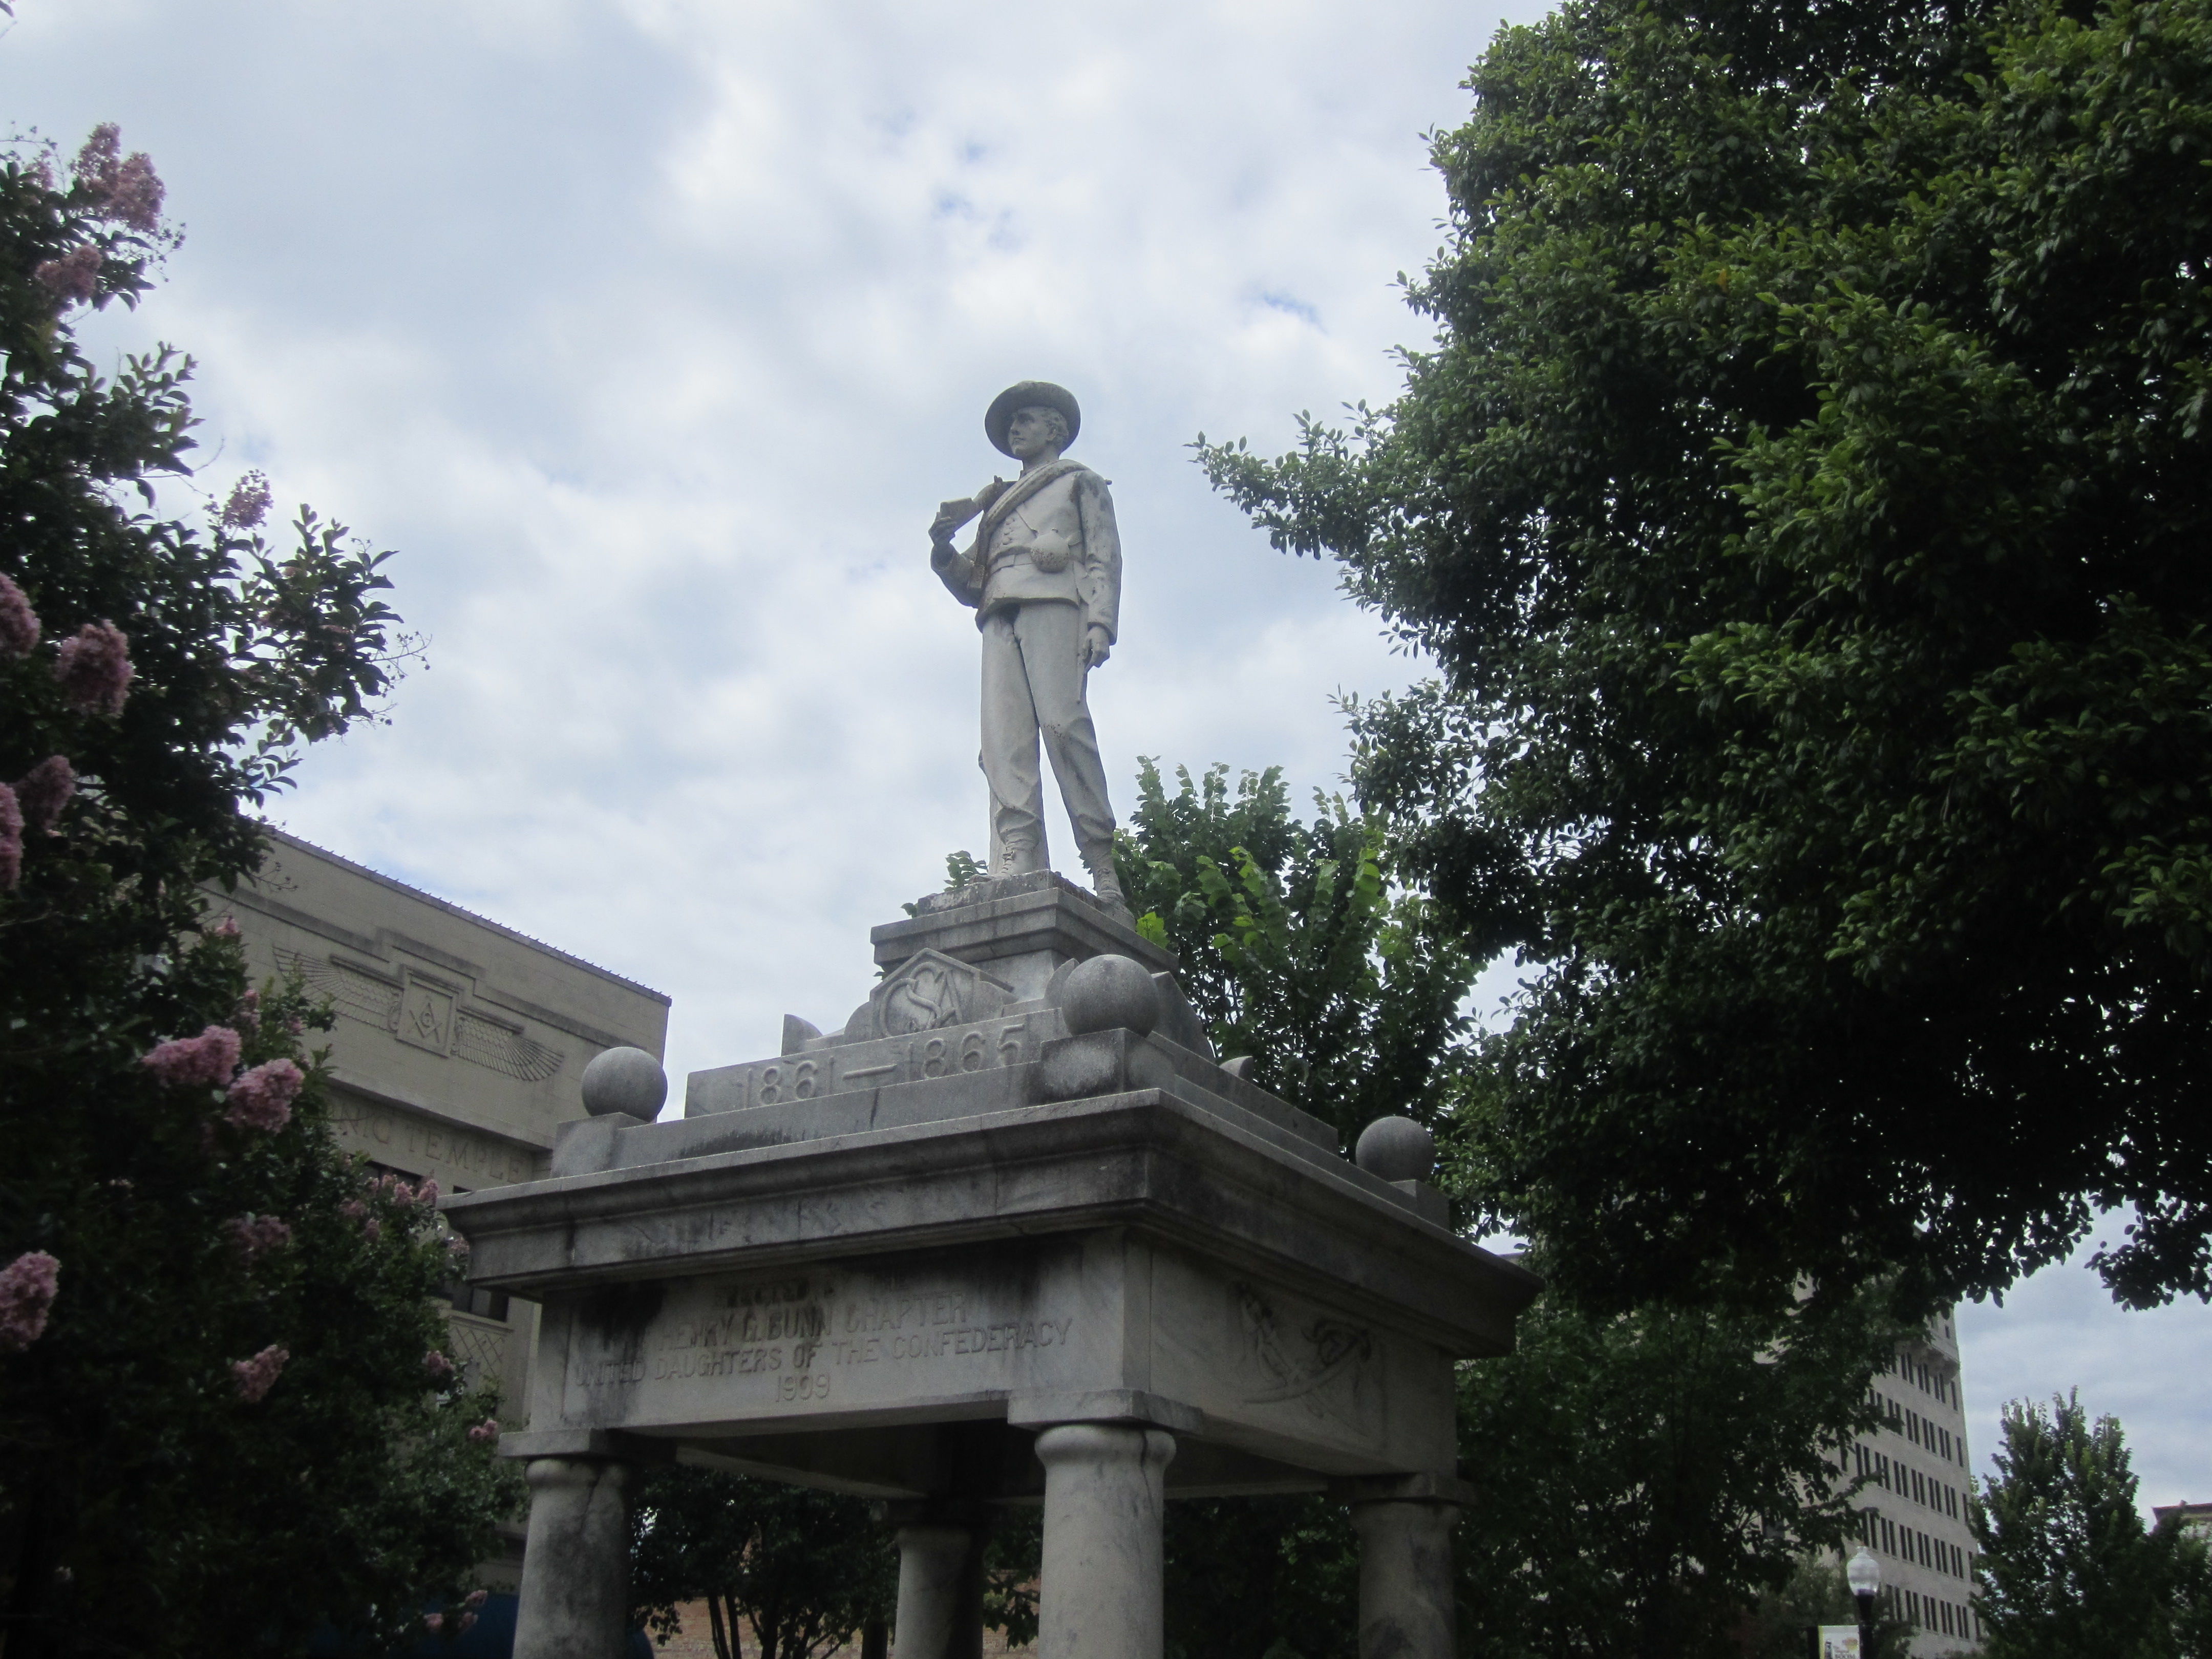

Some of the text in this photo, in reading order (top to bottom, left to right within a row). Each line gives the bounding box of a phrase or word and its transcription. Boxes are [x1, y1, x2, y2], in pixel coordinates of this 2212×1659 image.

[745, 1053, 836, 1108] 1861
[906, 1023, 1025, 1079] 1865
[405, 1124, 524, 1184] TEMPLE
[658, 1312, 735, 1351] HENRY
[768, 1301, 834, 1342] BUNN
[844, 1290, 967, 1333] CHAPTER
[576, 1317, 1073, 1387] UNITED DAUGHTERS OF THE CONFEDERACY
[775, 1372, 832, 1403] 1909
